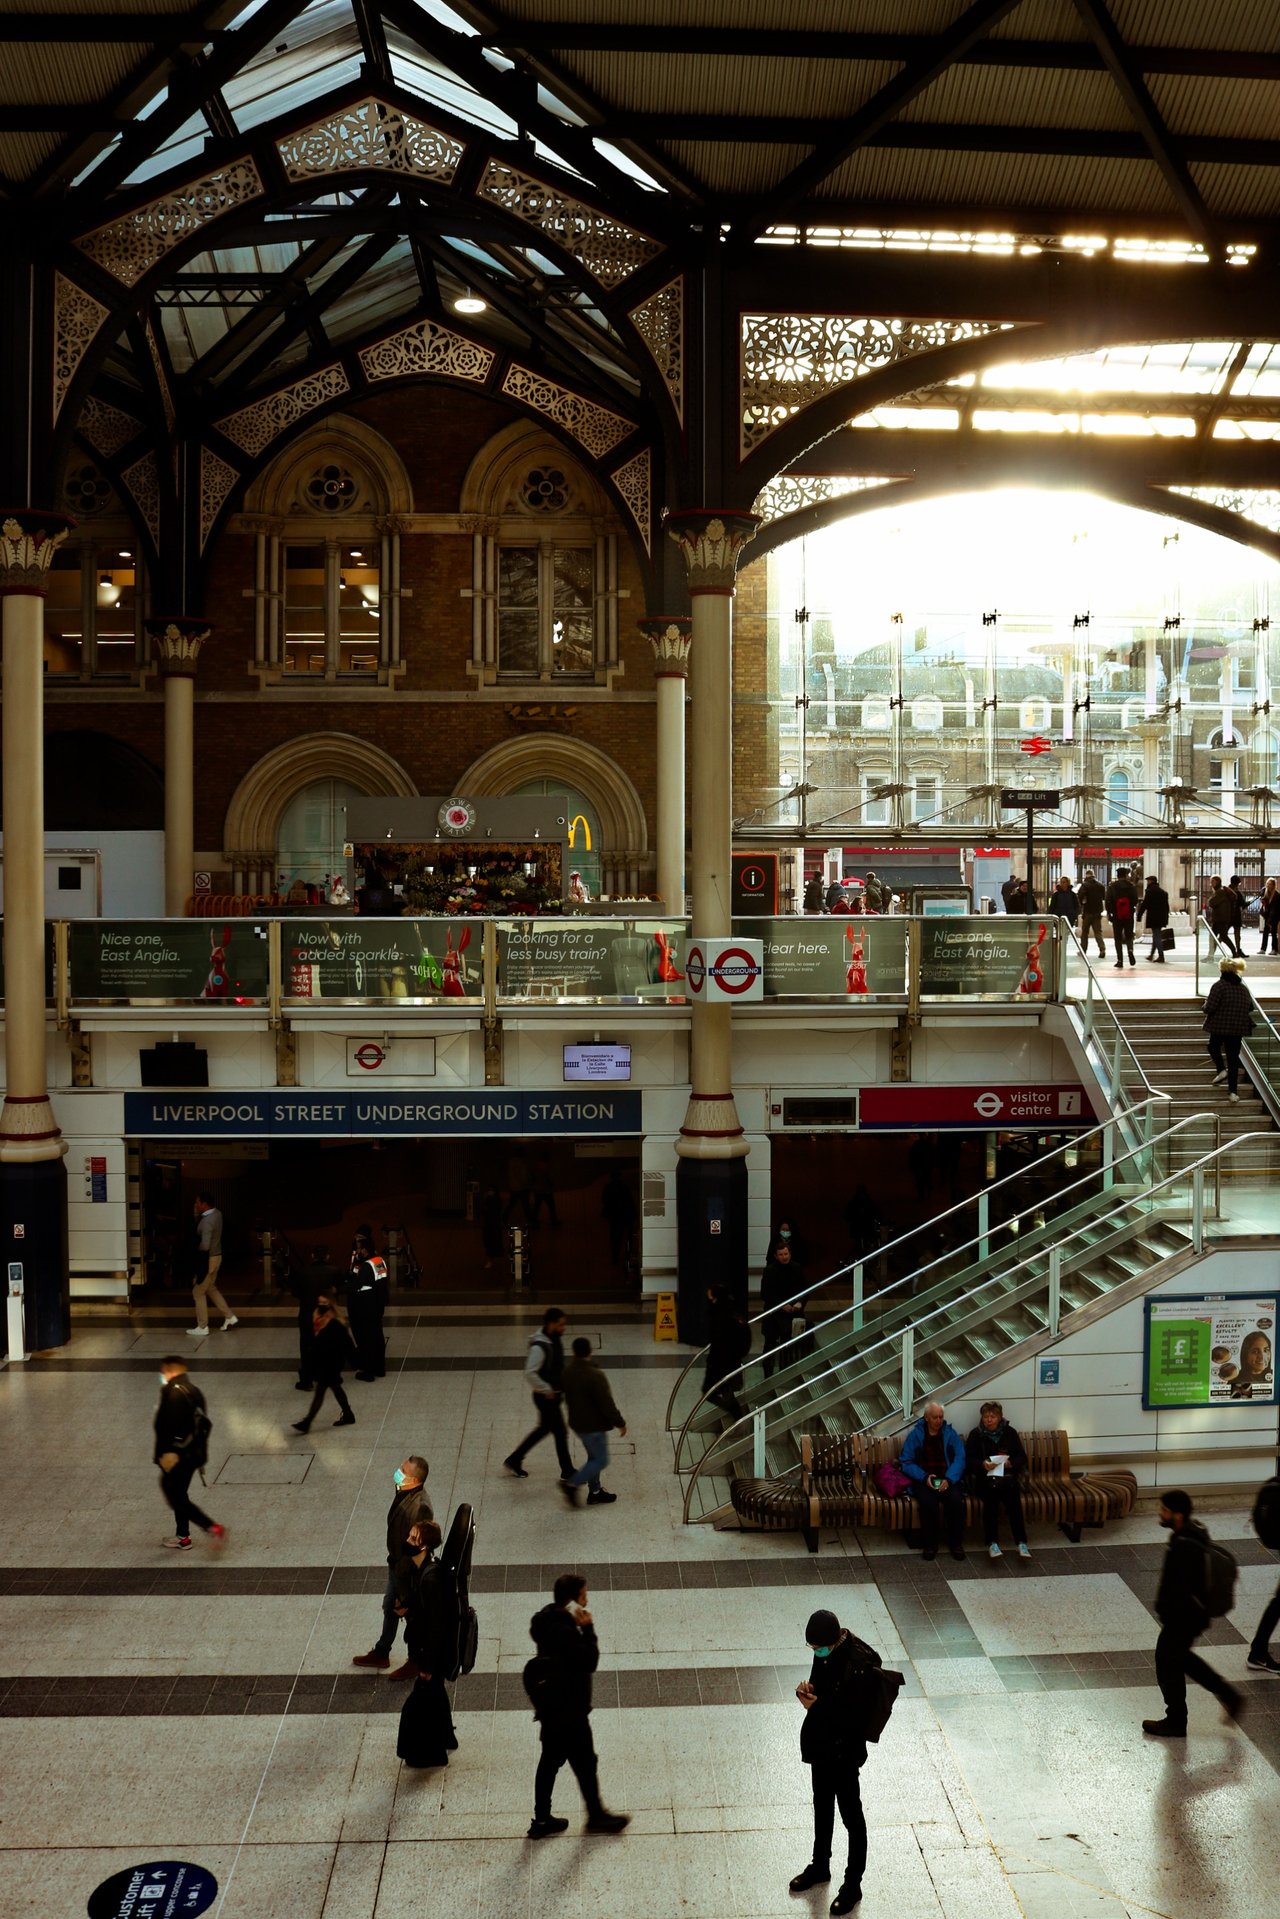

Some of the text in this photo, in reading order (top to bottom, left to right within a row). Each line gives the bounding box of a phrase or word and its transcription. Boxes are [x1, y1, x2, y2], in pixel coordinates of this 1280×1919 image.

[440, 800, 475, 816] FLOWER
[440, 818, 475, 835] STATION
[101, 933, 164, 947] Nice one,
[298, 932, 362, 945] Now with
[507, 932, 594, 946] Looking for a
[934, 931, 995, 944] Nice one,
[507, 948, 607, 962] less busy train?
[797, 942, 830, 954] here.
[934, 947, 1011, 961] East Anglia.
[101, 949, 180, 964] East Anglia.
[298, 948, 403, 964] added sparkle.
[1010, 1091, 1052, 1103] visitor
[152, 1103, 614, 1122] LIVERPOOL STREET UNDERGROUND STATION
[1010, 1105, 1052, 1115] centre
[165, 1868, 186, 1916] upper concourse
[136, 1904, 156, 1919] ift
